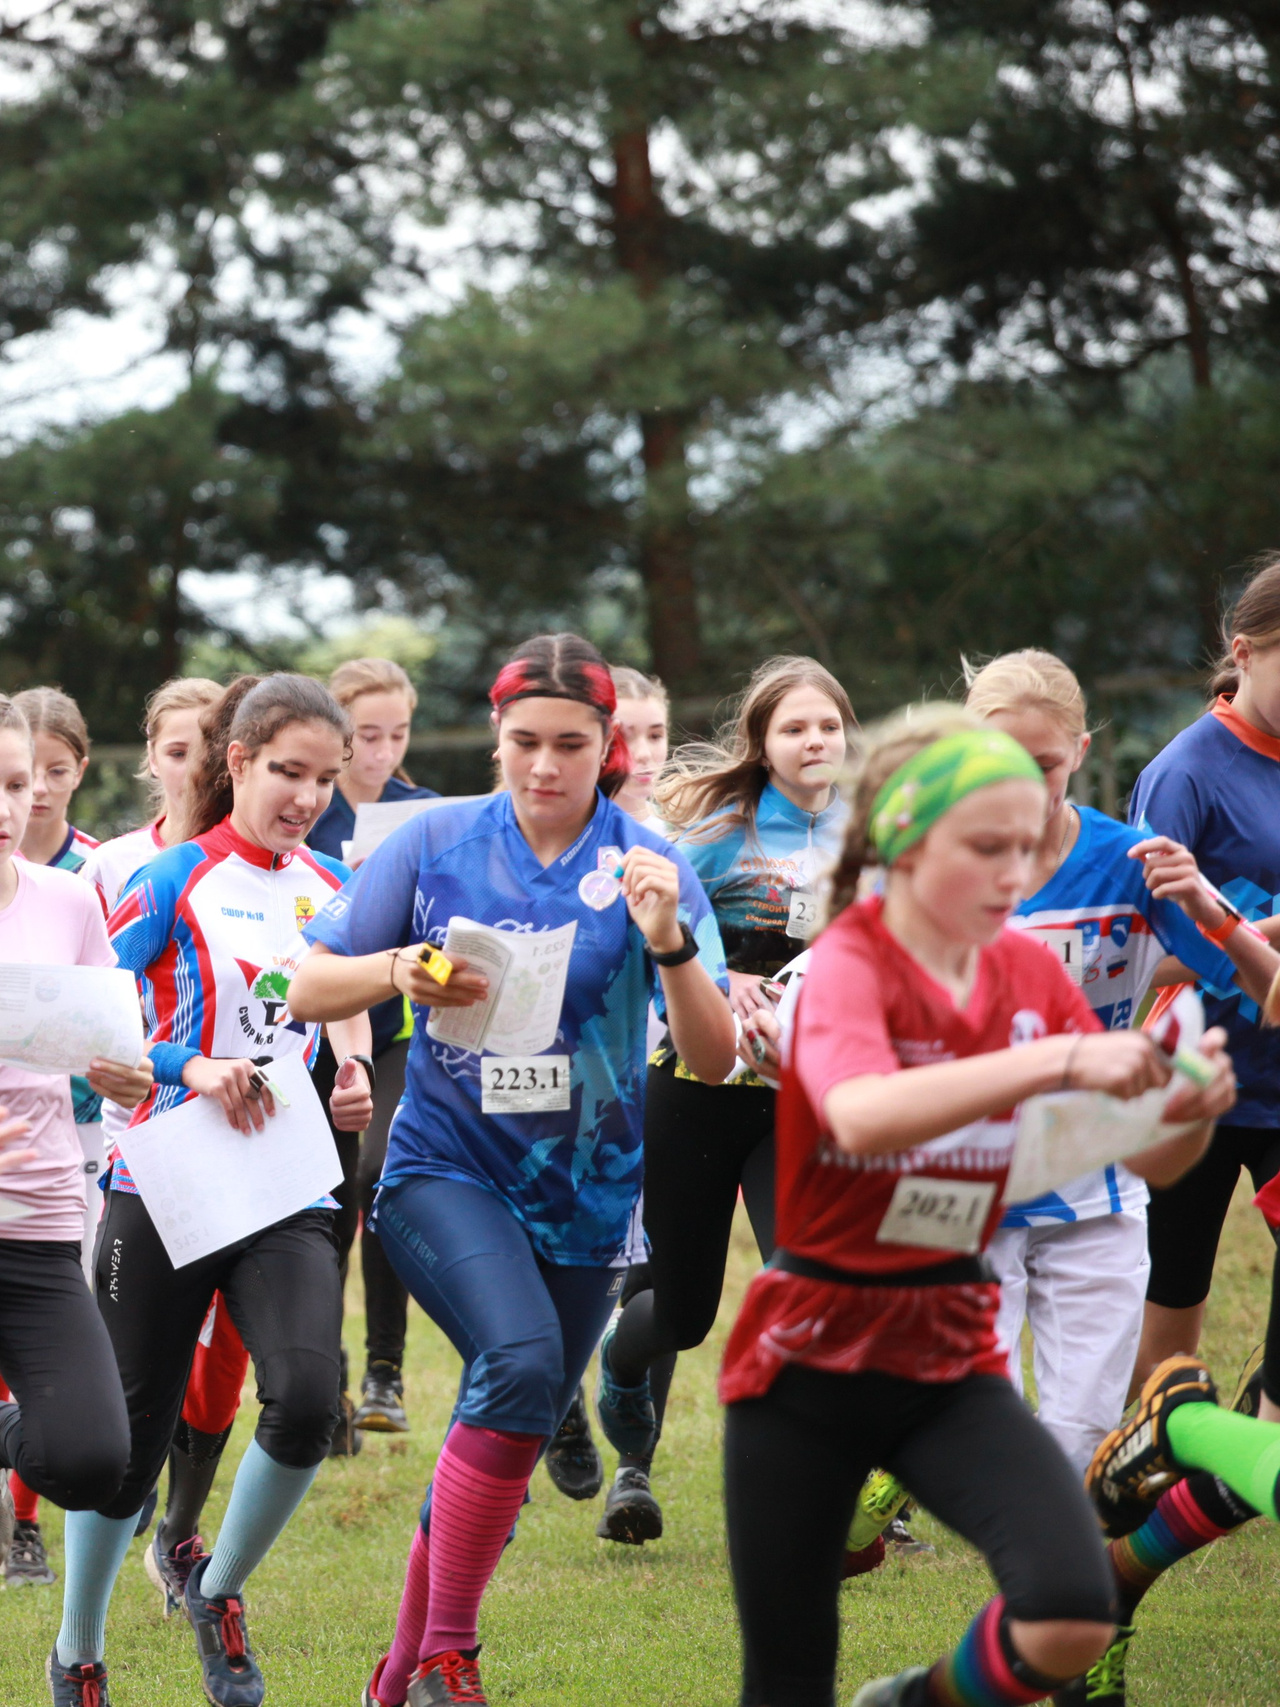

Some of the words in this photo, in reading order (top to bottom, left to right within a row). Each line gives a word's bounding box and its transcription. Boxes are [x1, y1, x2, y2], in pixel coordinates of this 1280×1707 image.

[221, 907, 245, 919] СШОР
[795, 901, 818, 923] 23
[238, 1005, 256, 1039] СШОР
[491, 1066, 561, 1091] 223.1
[898, 1189, 980, 1225] 202.1
